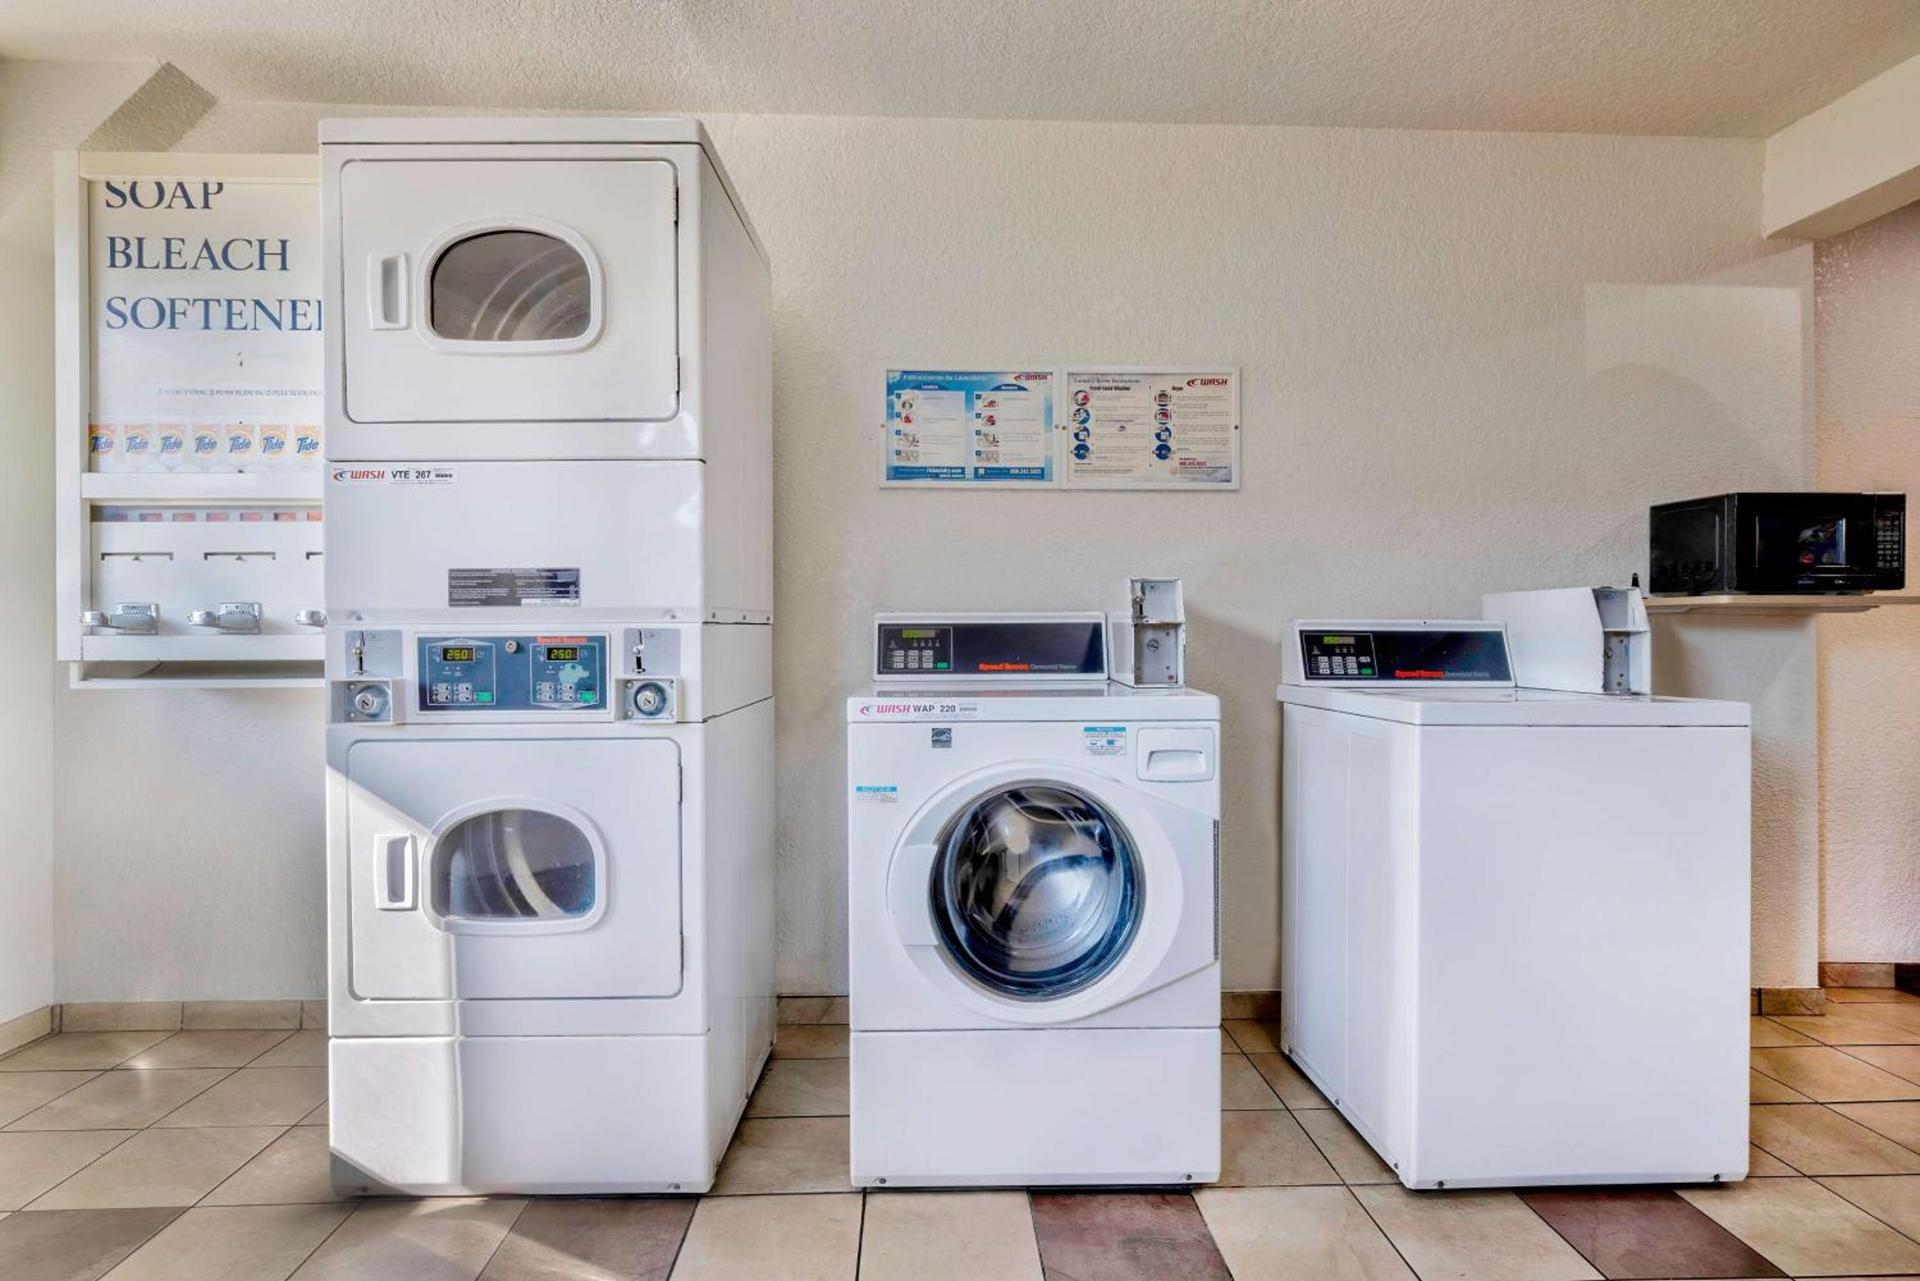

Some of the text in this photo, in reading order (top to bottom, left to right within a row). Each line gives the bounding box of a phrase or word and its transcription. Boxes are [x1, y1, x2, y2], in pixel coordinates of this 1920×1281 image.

[105, 181, 223, 209] SOAP
[106, 236, 290, 271] BLEACH
[105, 296, 322, 331] SOFTENE
[1200, 378, 1228, 386] WASH
[92, 436, 113, 453] Tide
[126, 436, 149, 453] Tide
[161, 436, 183, 453] Tide
[195, 436, 218, 453] Tide
[229, 436, 252, 453] Tide
[262, 436, 285, 453] Tide
[296, 436, 319, 453] Tide
[350, 470, 385, 479] WASH
[391, 471, 410, 479] VTE
[877, 704, 911, 713] WASH
